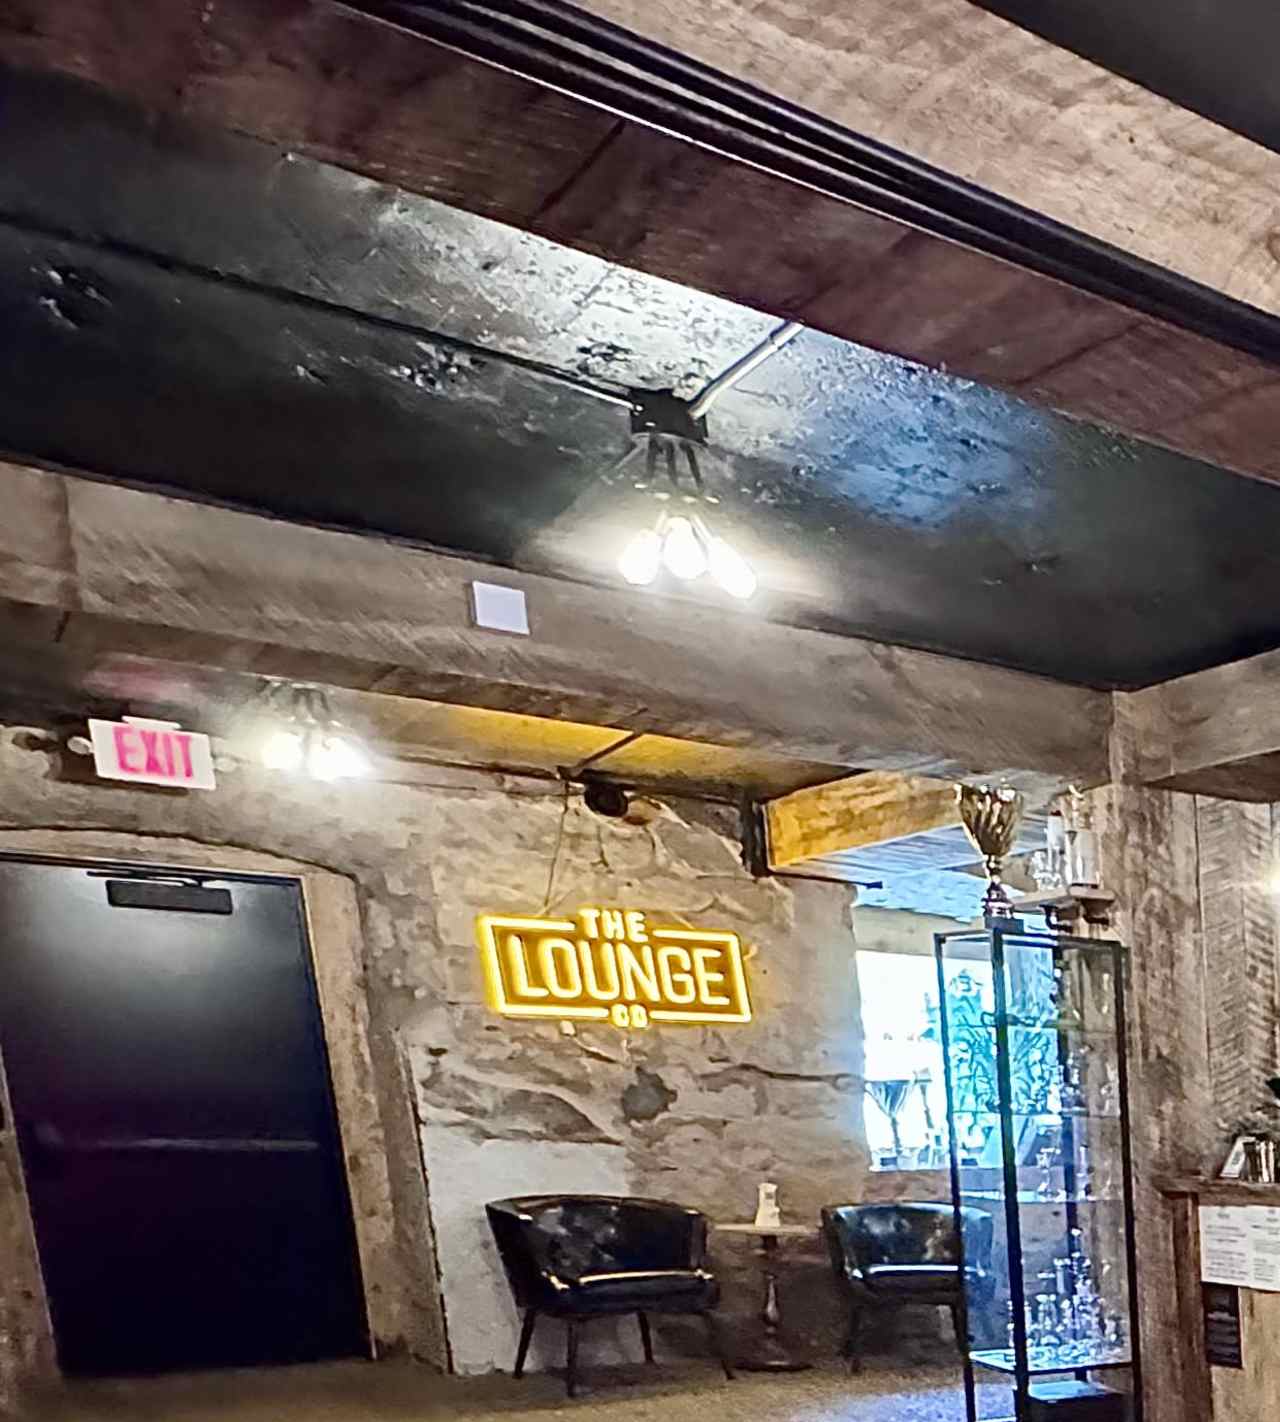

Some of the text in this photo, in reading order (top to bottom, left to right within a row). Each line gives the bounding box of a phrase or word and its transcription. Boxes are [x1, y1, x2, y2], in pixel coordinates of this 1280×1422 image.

[112, 726, 193, 778] EXIT
[578, 908, 649, 942] THE
[507, 934, 731, 1006] LOUNGE
